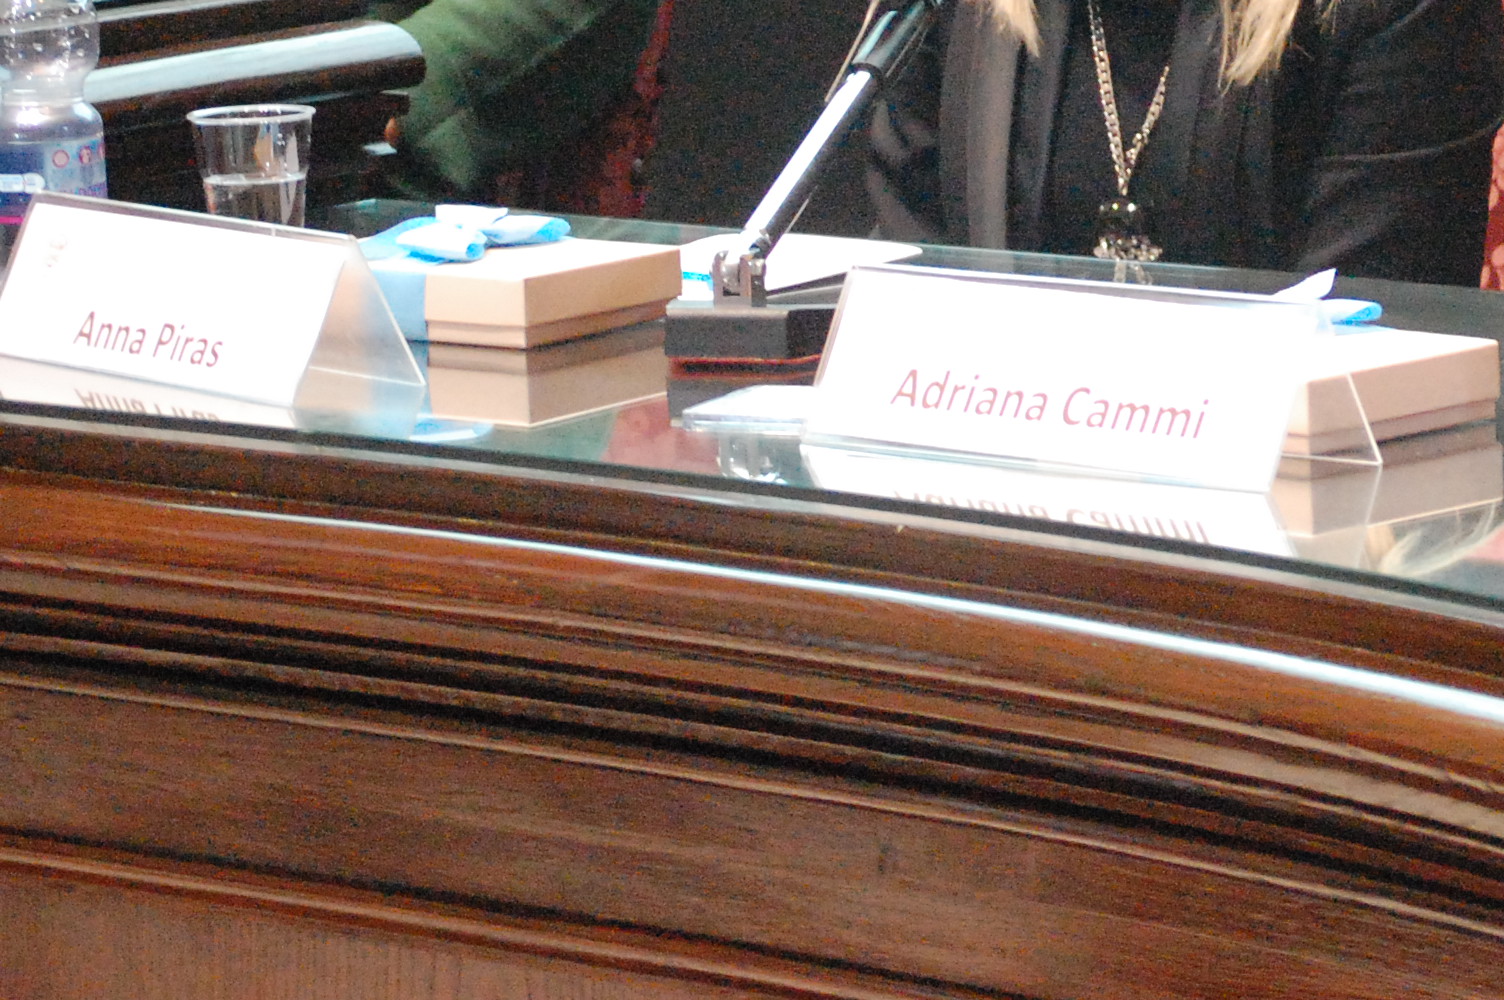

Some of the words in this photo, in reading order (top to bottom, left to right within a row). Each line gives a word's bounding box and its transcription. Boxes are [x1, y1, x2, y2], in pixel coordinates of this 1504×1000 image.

[72, 310, 147, 355] Anna
[152, 323, 224, 368] Piras
[890, 366, 1049, 421] Adriana
[1062, 385, 1210, 440] Cammi
